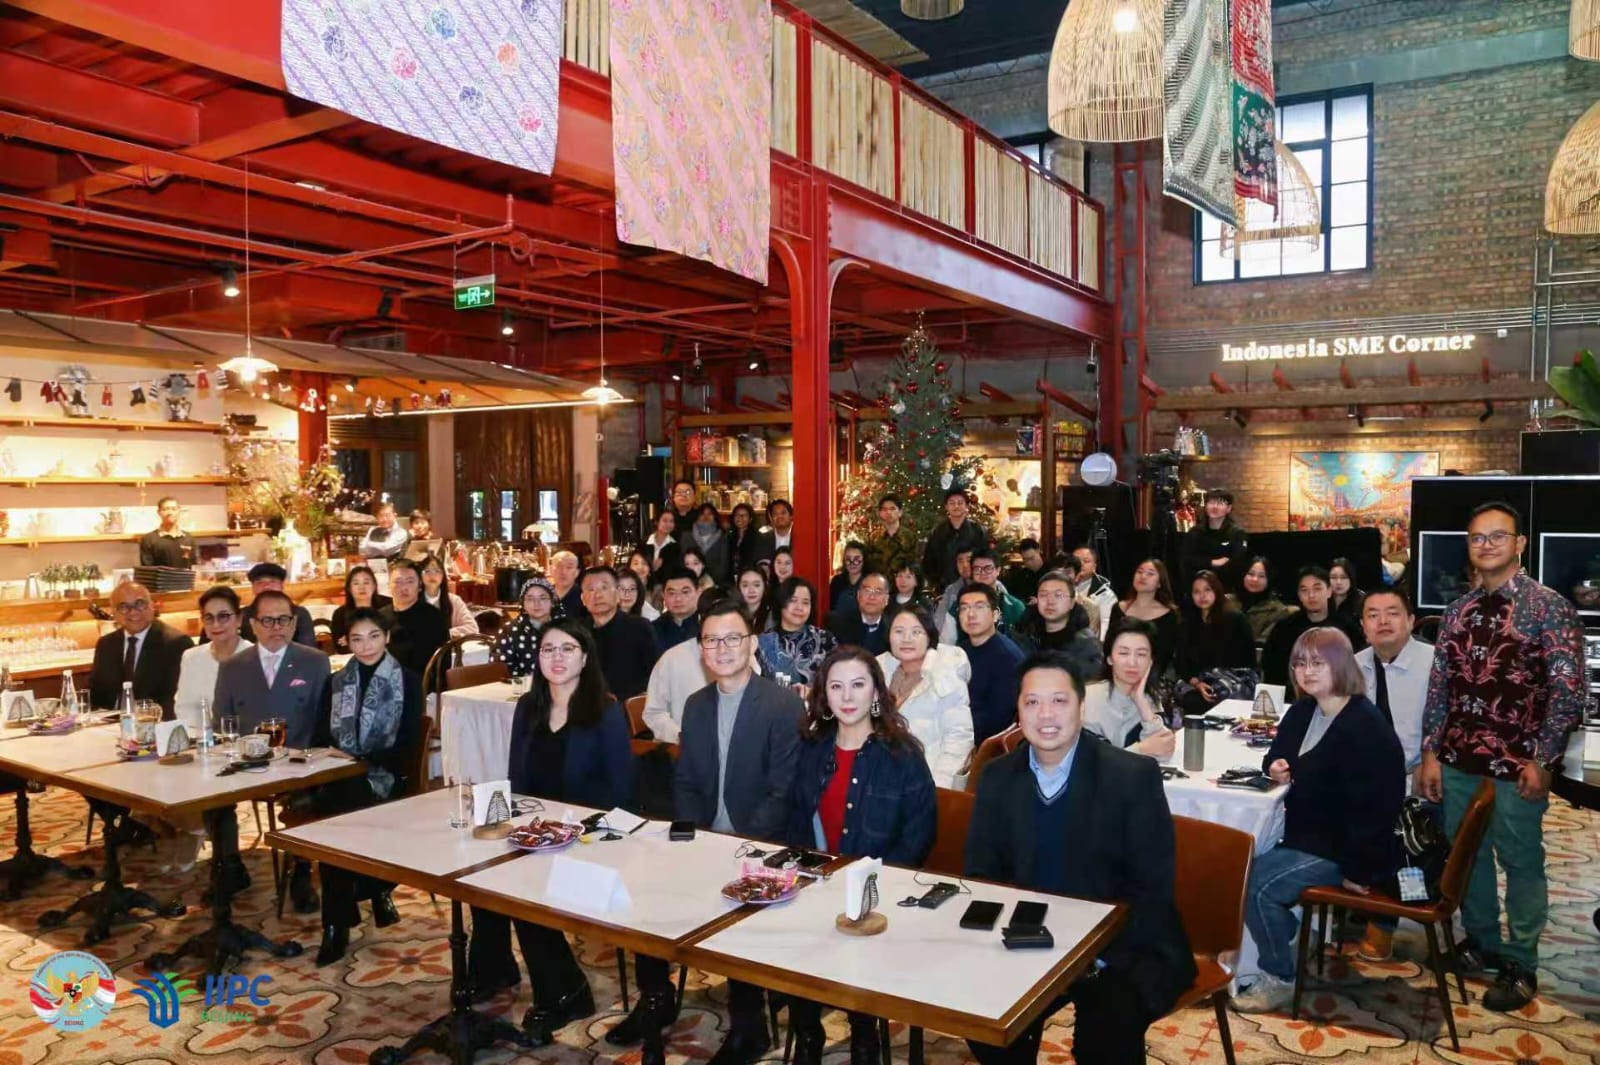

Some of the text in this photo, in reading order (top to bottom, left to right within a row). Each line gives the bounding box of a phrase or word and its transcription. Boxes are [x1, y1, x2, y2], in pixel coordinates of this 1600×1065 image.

[1221, 334, 1475, 361] Indonesia SME Corner
